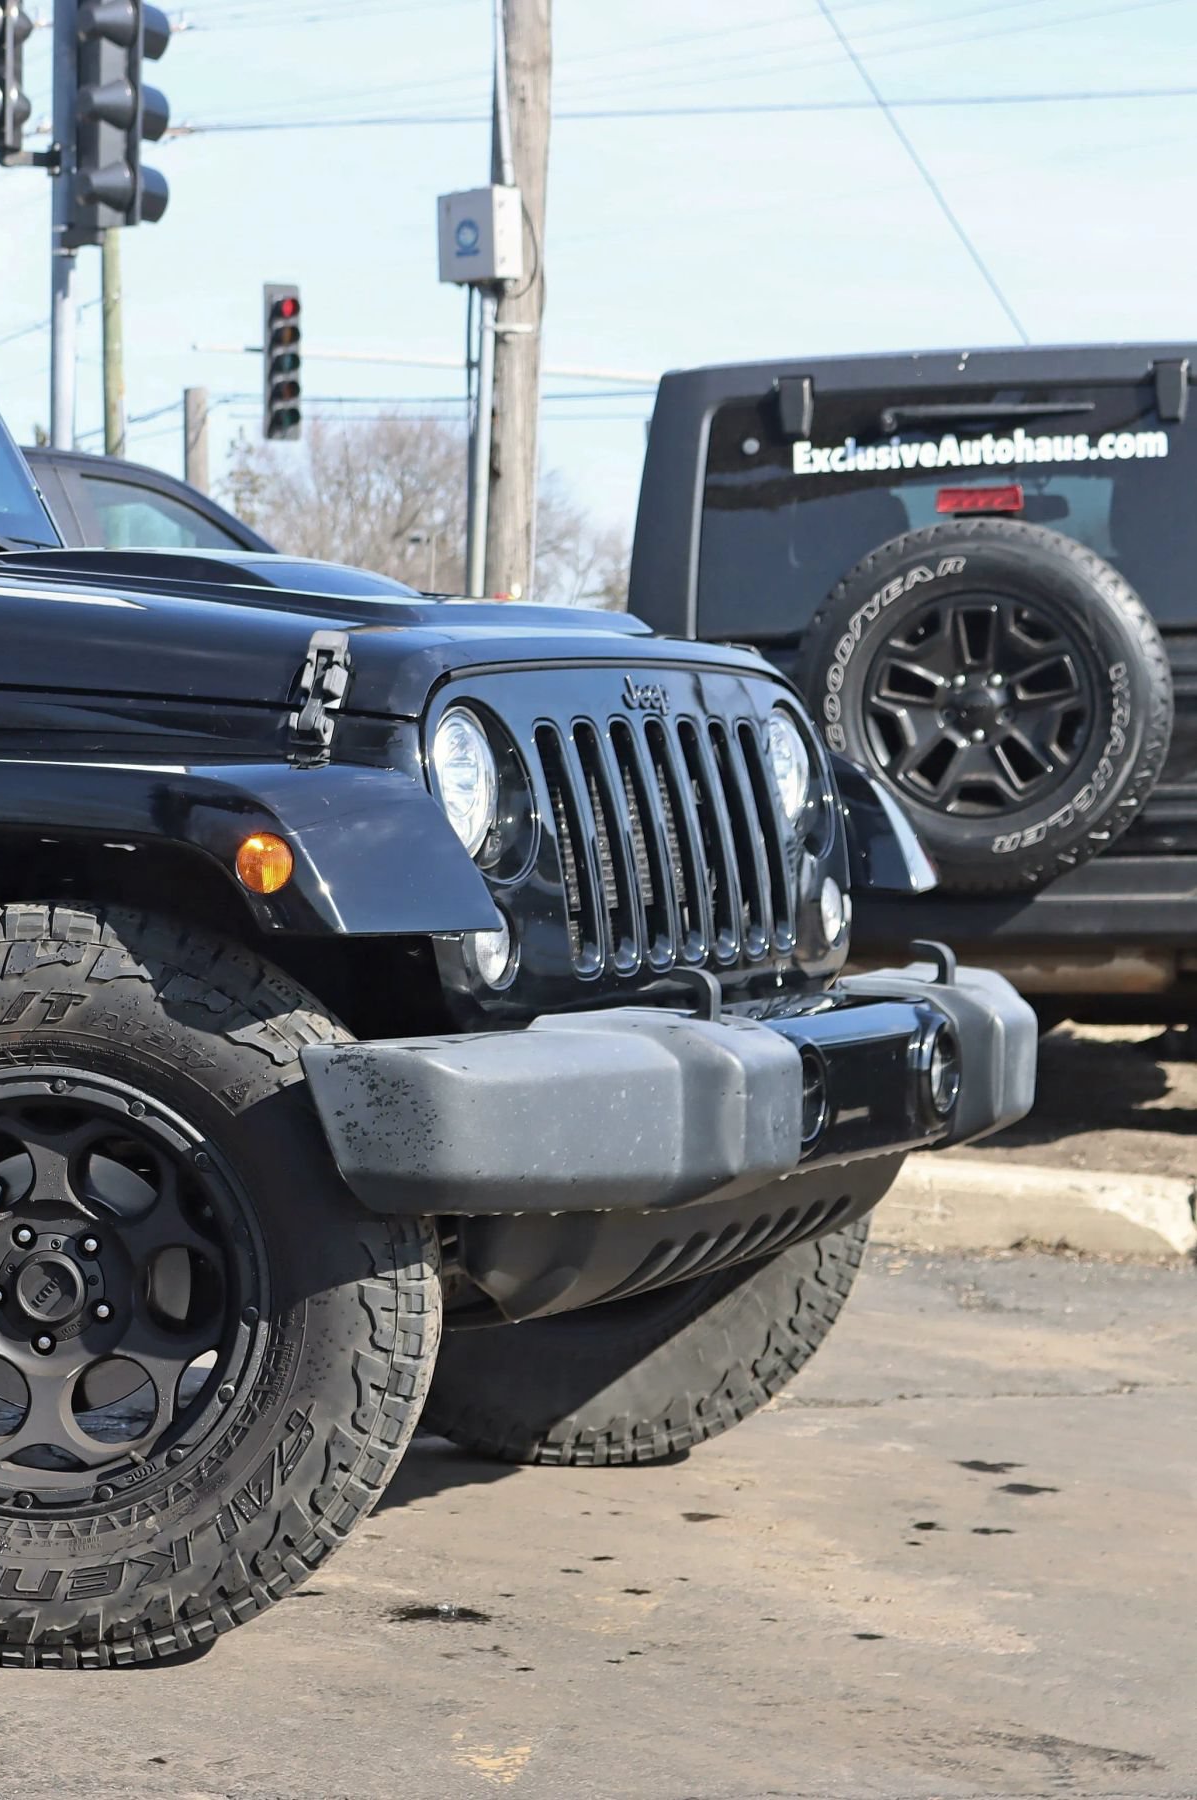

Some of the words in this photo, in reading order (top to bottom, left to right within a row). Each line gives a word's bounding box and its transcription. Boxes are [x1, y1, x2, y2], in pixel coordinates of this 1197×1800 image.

[792, 428, 1168, 474] ExclusiveAutohaus.com
[621, 674, 670, 716] Jeep
[823, 556, 967, 752] GOODYEAR
[991, 660, 1131, 854] WRANGLER
